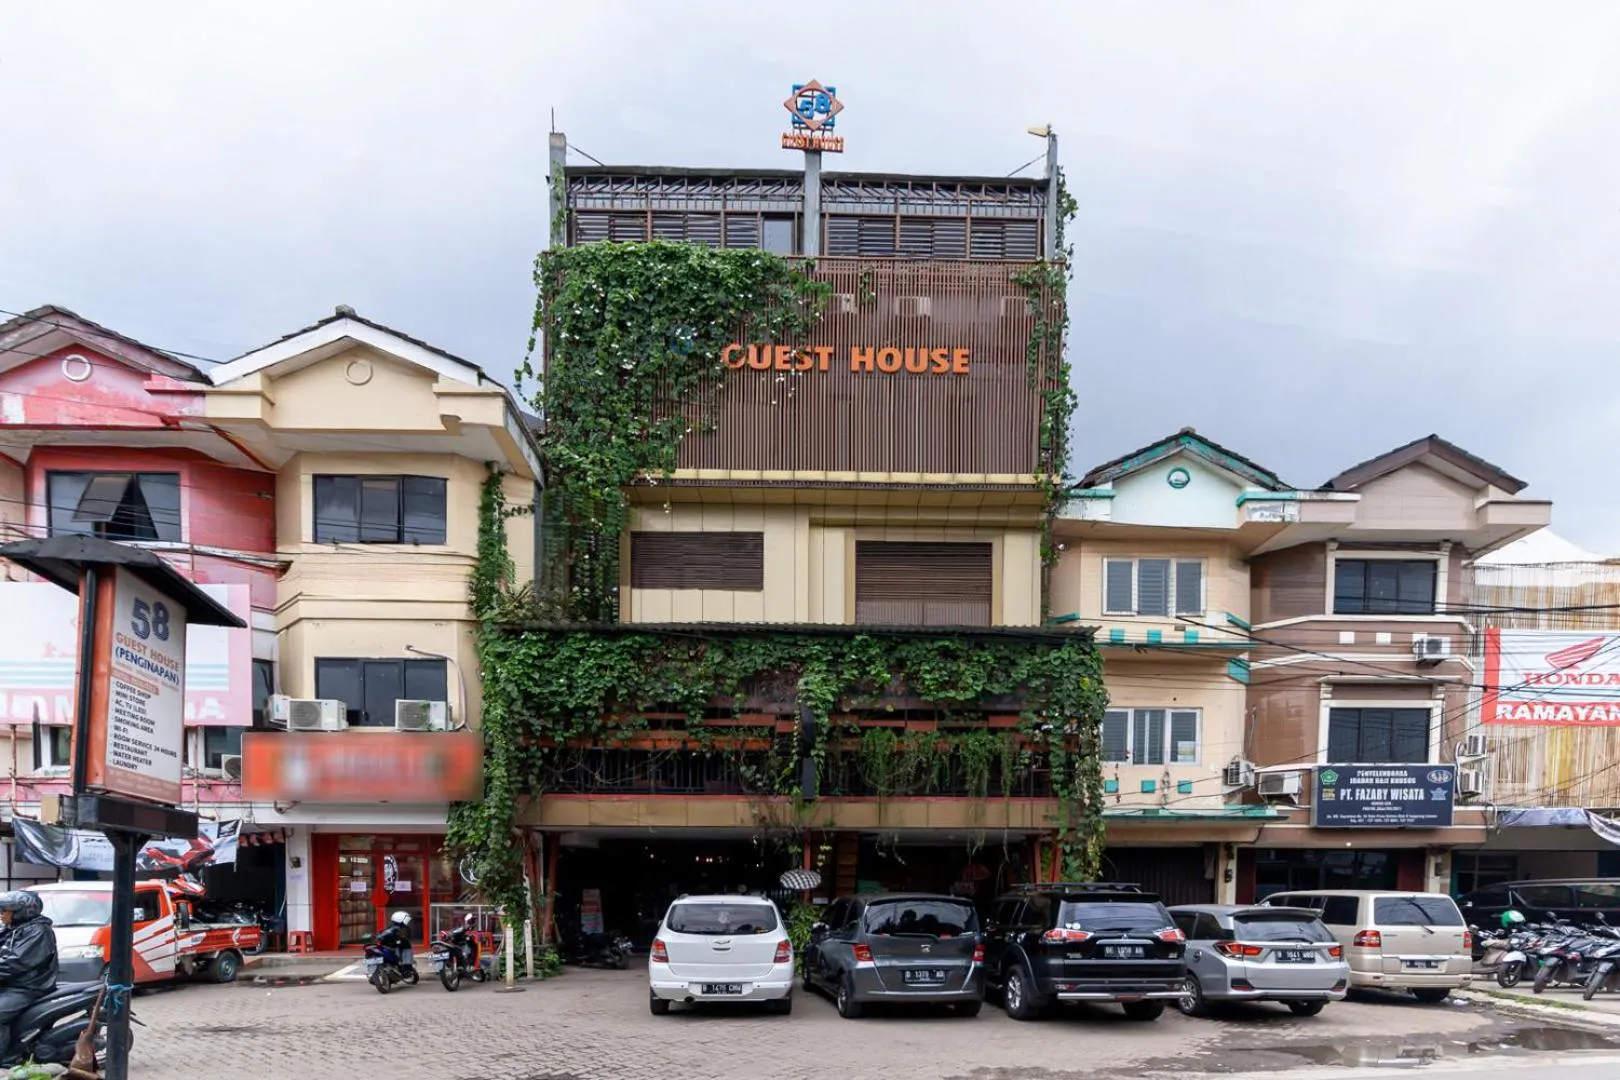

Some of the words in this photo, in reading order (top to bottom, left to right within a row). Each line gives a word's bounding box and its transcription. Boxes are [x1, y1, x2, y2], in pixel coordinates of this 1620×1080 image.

[799, 93, 831, 120] 58
[850, 344, 970, 375] HOUSE
[130, 595, 170, 642] 58
[115, 632, 148, 656] GUEST
[150, 649, 180, 672] HOUSE
[115, 646, 179, 686] (PENGINAPAN)
[1523, 672, 1620, 685] HONDA
[115, 680, 136, 694] COFFEE
[137, 689, 151, 699] SHOP
[114, 707, 139, 720] MEETING
[139, 716, 155, 726] ROOM
[114, 715, 140, 729] SMOKING
[113, 733, 131, 743] ROOM
[131, 738, 152, 750] SERVICE
[113, 741, 148, 756] RESTAURANT
[113, 750, 132, 760] WATER
[132, 755, 152, 766] HEATER
[113, 759, 138, 770] LAUNDRY
[1340, 788, 1353, 800] PT.
[1390, 788, 1425, 800] WISATA
